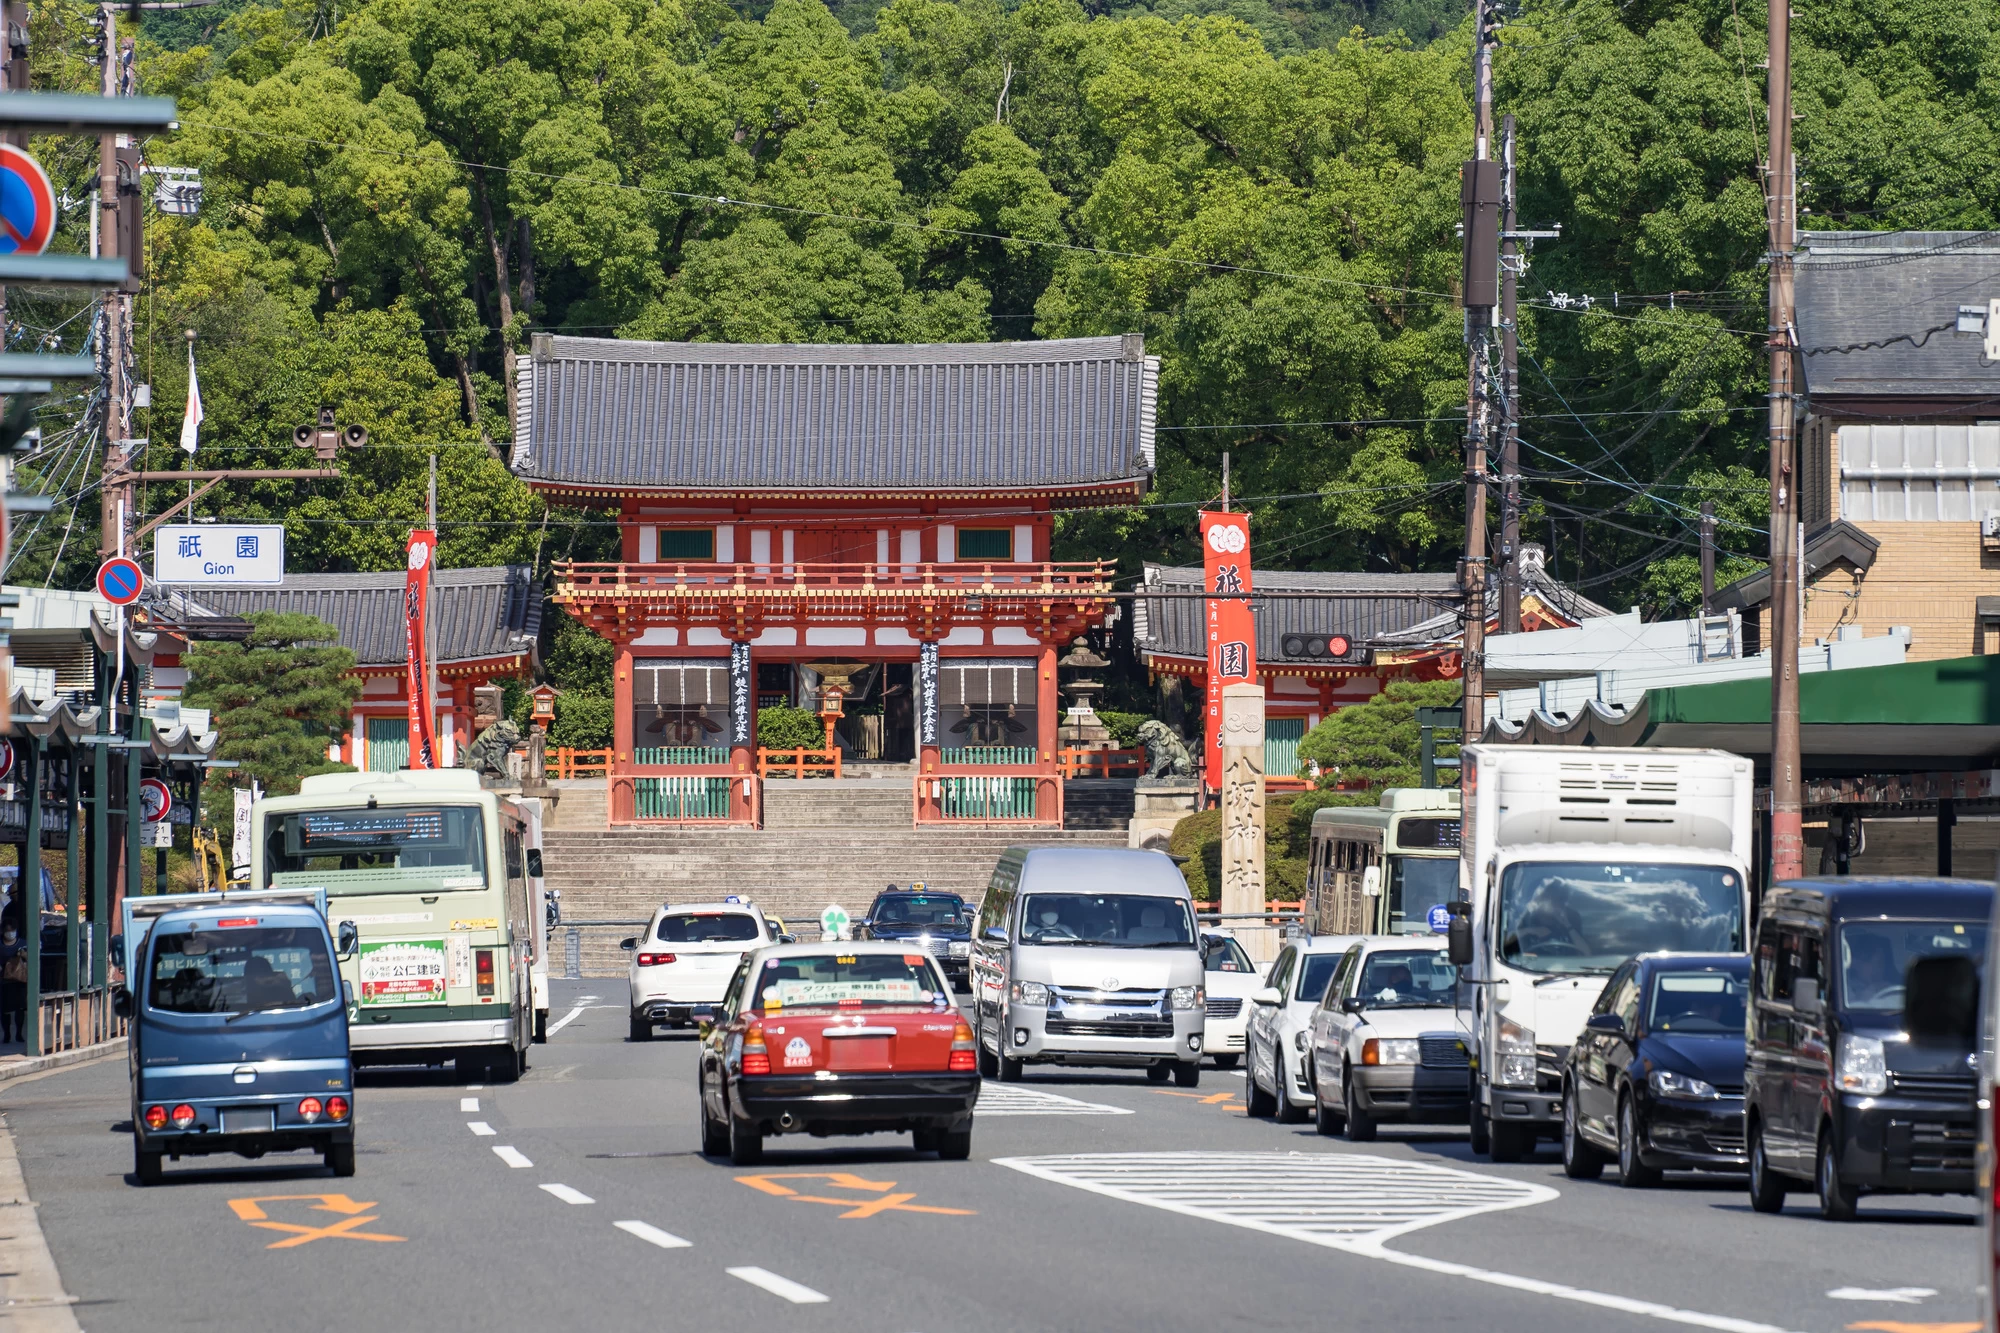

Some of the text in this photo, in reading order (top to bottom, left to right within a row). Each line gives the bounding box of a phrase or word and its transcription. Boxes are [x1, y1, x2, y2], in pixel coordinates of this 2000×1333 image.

[178, 535, 259, 558] 祇園
[203, 562, 234, 575] Gion
[740, 644, 750, 672] 七月七日
[929, 644, 938, 675] 七月二日
[1225, 756, 1262, 890] 八坂神社
[393, 963, 441, 977] 公仁建設
